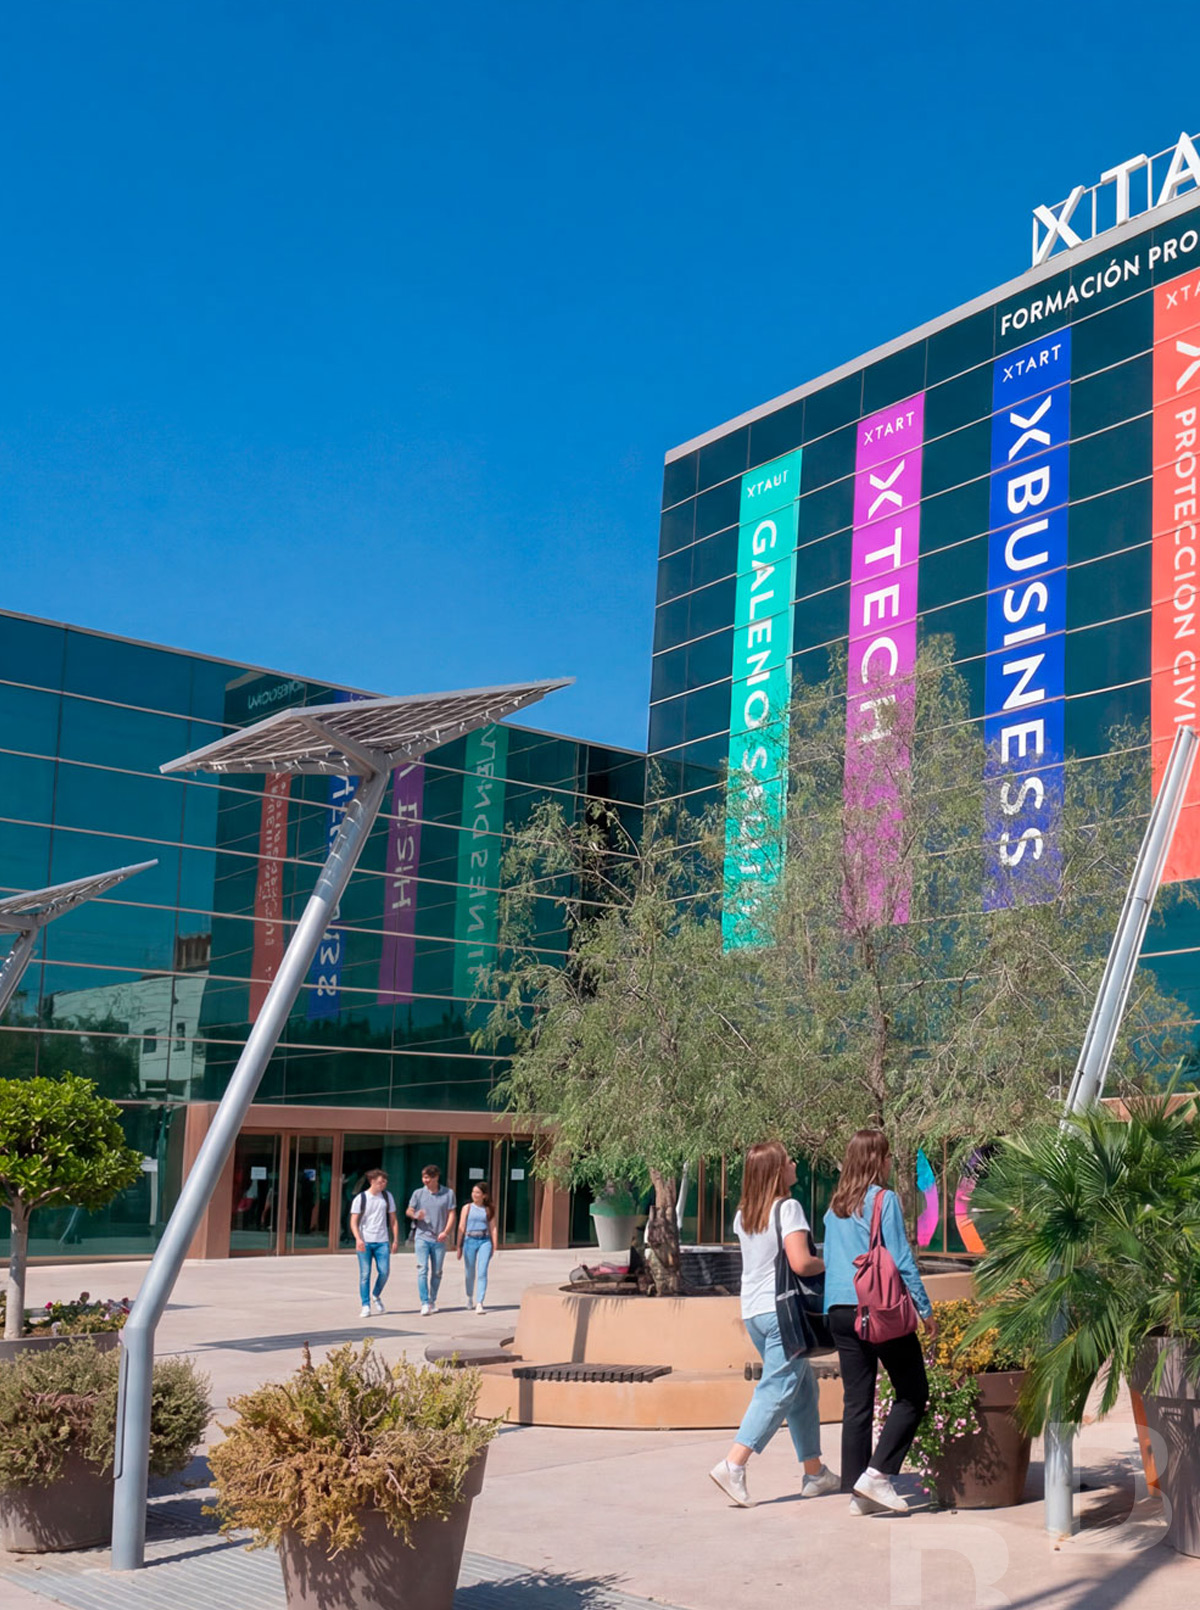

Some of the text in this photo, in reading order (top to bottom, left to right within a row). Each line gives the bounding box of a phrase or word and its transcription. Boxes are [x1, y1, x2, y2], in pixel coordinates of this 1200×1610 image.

[1001, 254, 1140, 336] FORMACIÓN
[1003, 343, 1062, 383] XTART
[863, 411, 916, 446] XTART
[1173, 406, 1197, 723] PROTECCION CIVI
[743, 518, 778, 731] GALENO
